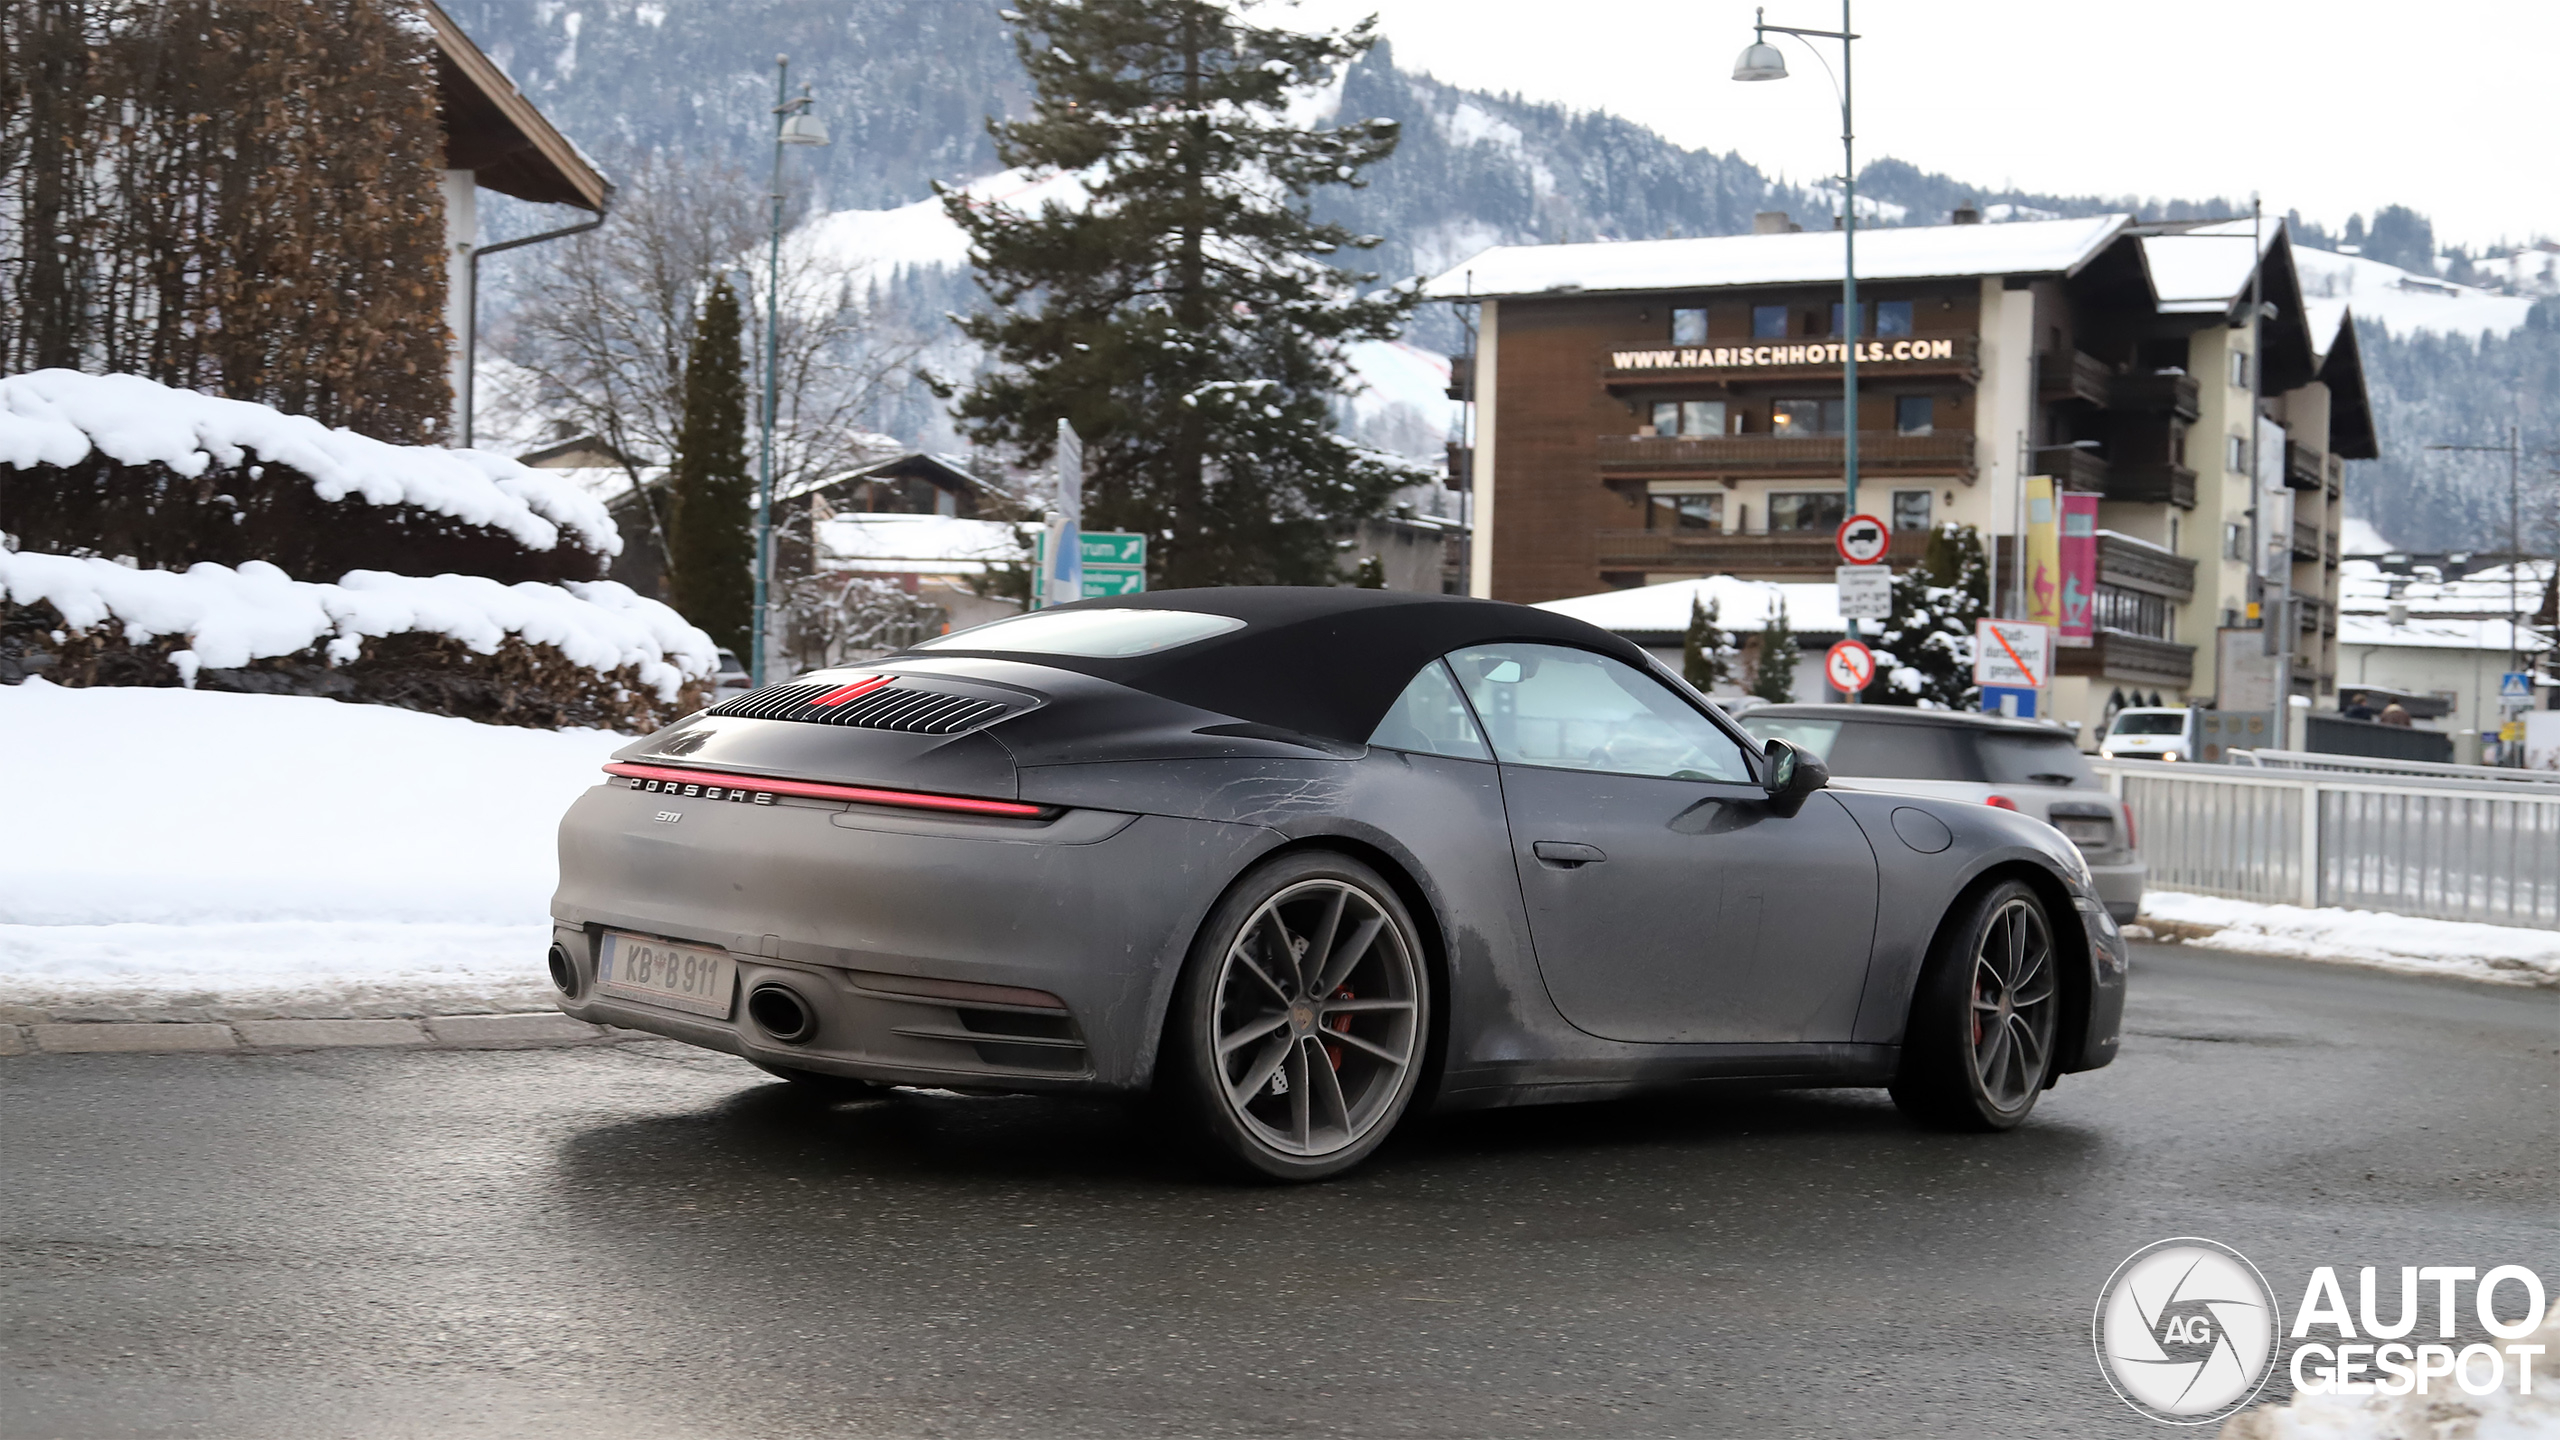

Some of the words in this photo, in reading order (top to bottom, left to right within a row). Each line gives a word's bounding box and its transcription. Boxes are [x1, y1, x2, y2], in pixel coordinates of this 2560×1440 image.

[630, 778, 773, 804] PORSCHE
[655, 810, 682, 823] 911
[625, 944, 653, 983] KB
